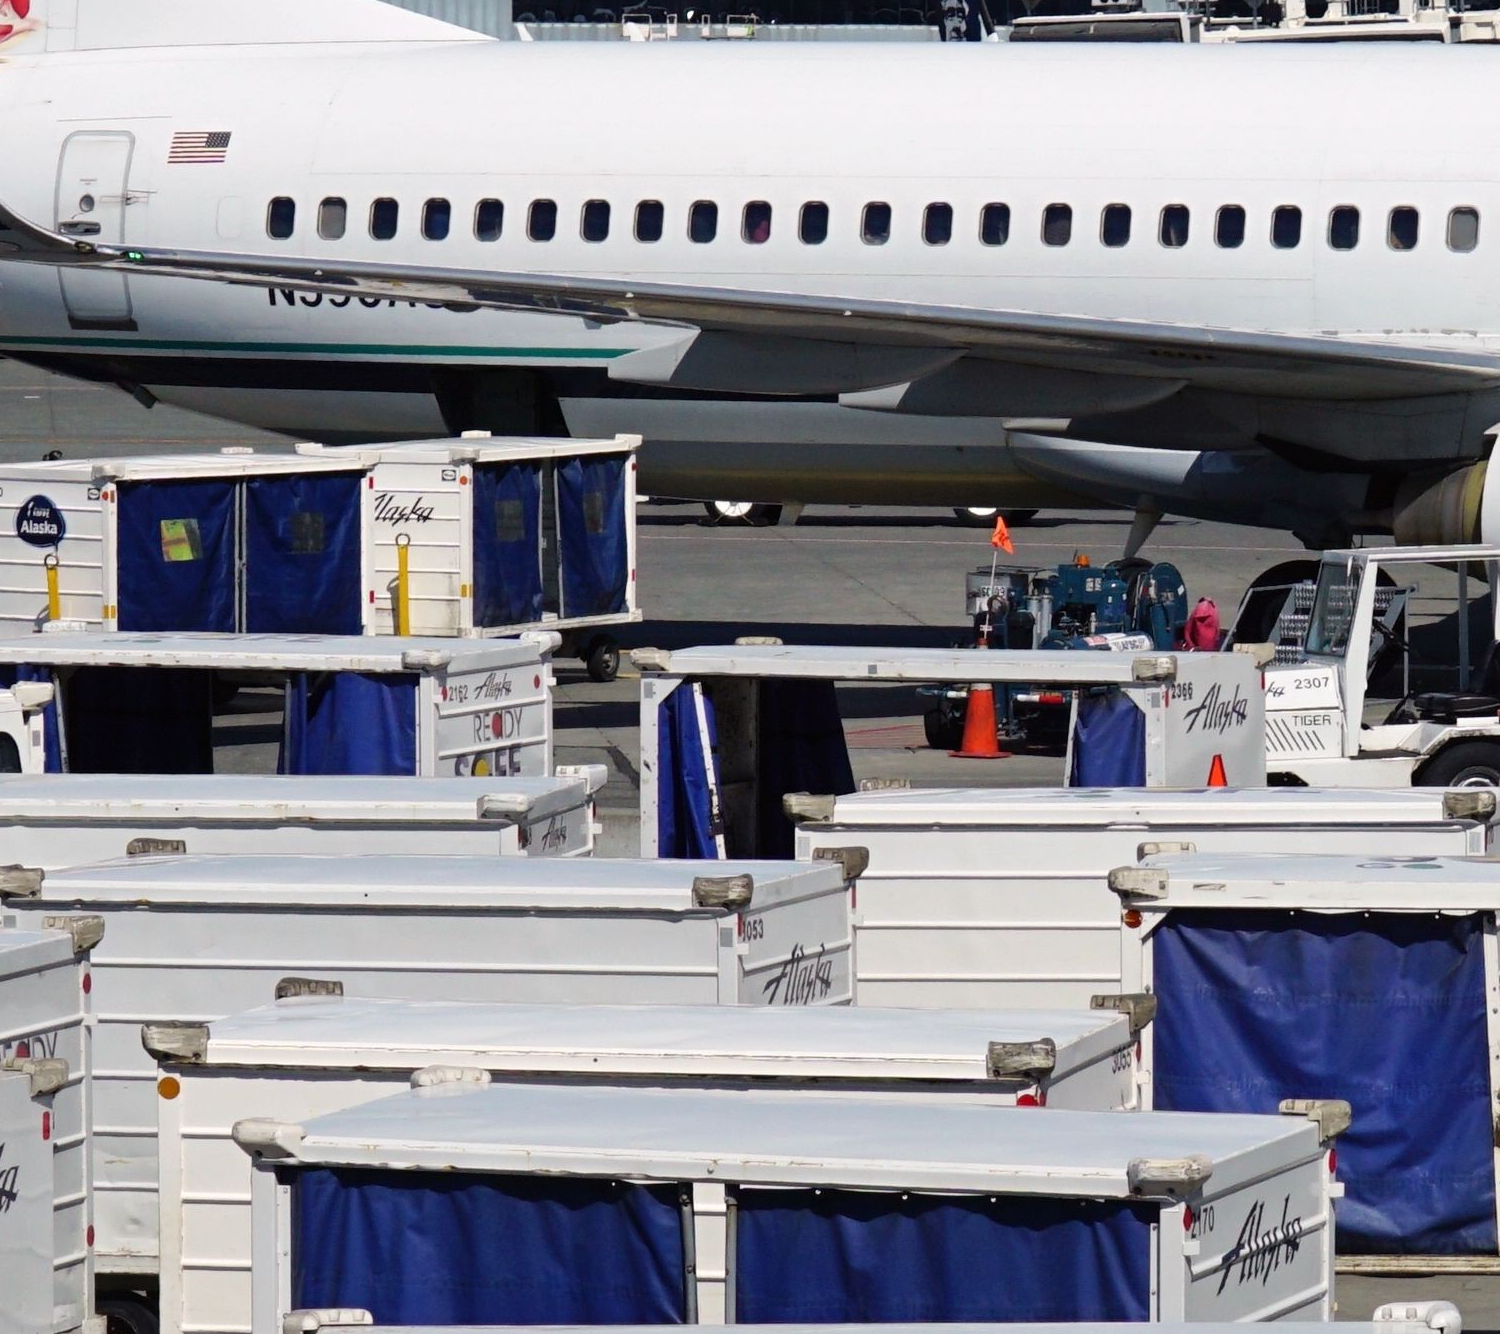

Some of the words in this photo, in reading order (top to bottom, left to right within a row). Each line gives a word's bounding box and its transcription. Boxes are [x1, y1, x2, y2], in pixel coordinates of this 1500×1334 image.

[20, 519, 58, 535] Alaska
[448, 686, 469, 704] 2162
[474, 672, 512, 702] Alaska
[1171, 682, 1193, 701] 2366
[1294, 677, 1330, 689] 2307
[1183, 682, 1248, 735] Alaska
[1292, 714, 1332, 727] TIGER
[763, 942, 833, 1005] Alaska
[1191, 1205, 1215, 1240] 2170
[1217, 1193, 1303, 1296] Alaska
